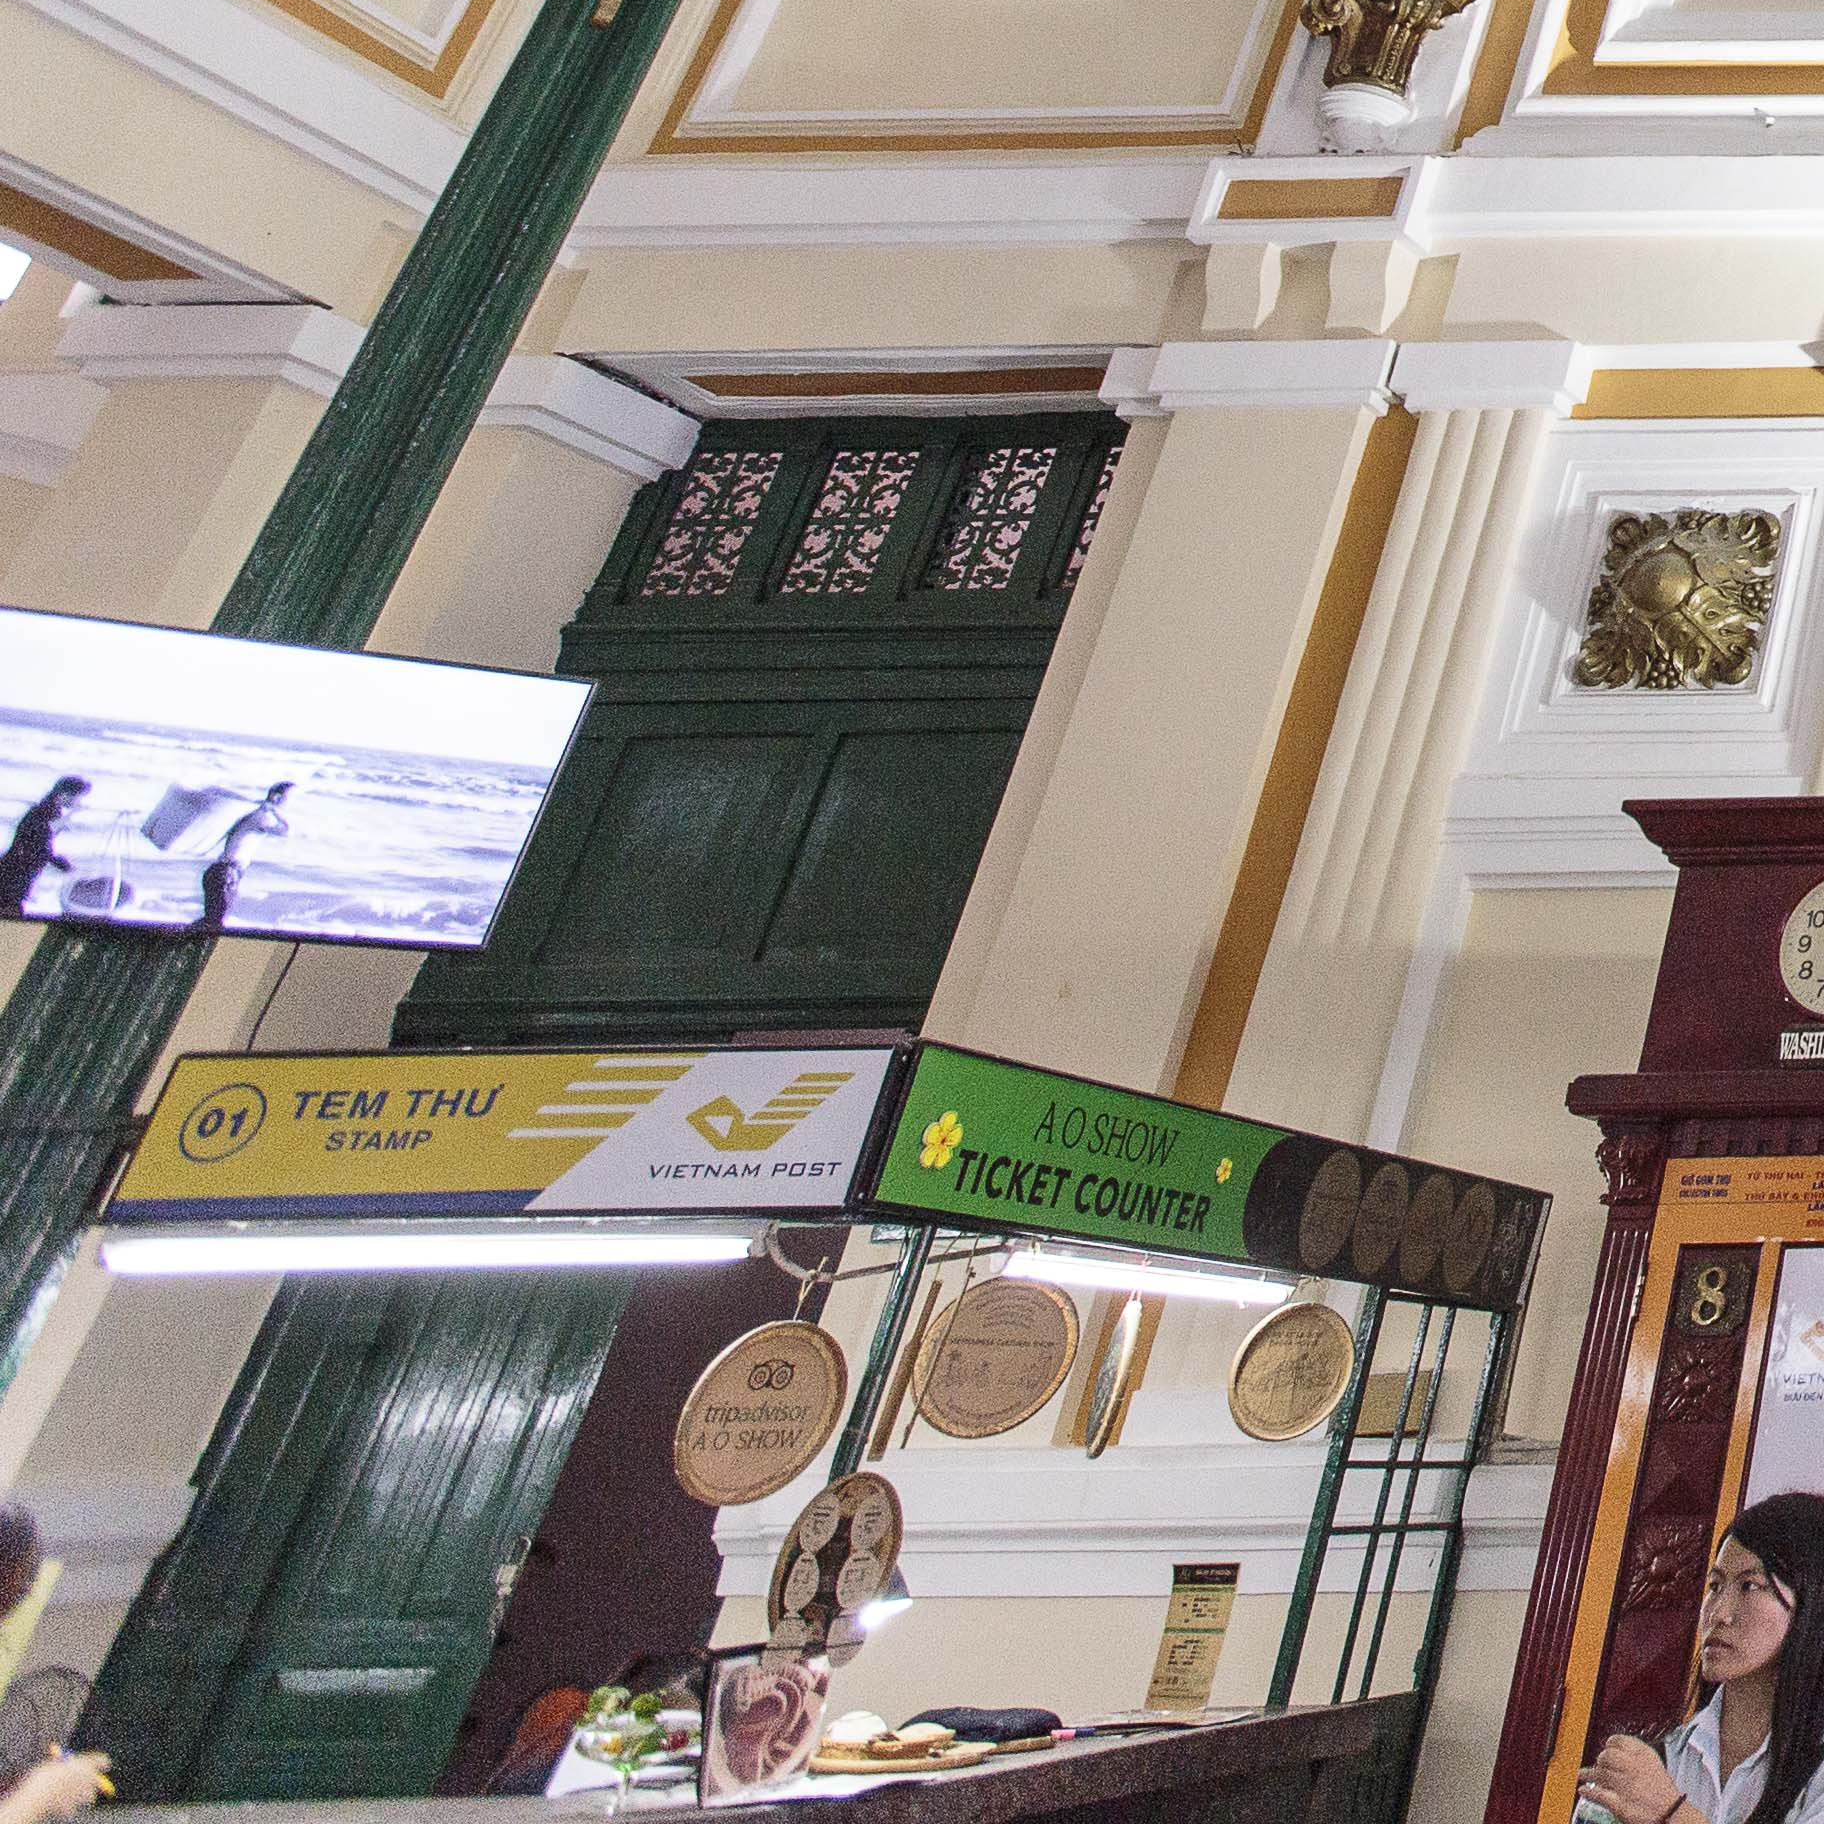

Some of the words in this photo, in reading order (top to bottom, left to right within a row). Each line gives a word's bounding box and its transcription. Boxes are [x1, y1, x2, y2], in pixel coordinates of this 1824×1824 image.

[1797, 935, 1812, 953] 9
[1799, 960, 1813, 980] 8
[293, 1088, 390, 1120] TEM
[405, 1083, 505, 1119] THƯ
[196, 1107, 249, 1139] 01
[324, 1129, 433, 1152] STAMP
[1086, 1114, 1182, 1169] SHOW
[649, 1161, 760, 1179] VIETNAM
[770, 1161, 843, 1177] POST
[953, 1148, 1070, 1209] TICKET
[1073, 1172, 1211, 1234] COUNTER
[1691, 1266, 1727, 1326] 8
[704, 1400, 812, 1425] tripadvisor
[736, 1428, 804, 1451] SHOW
